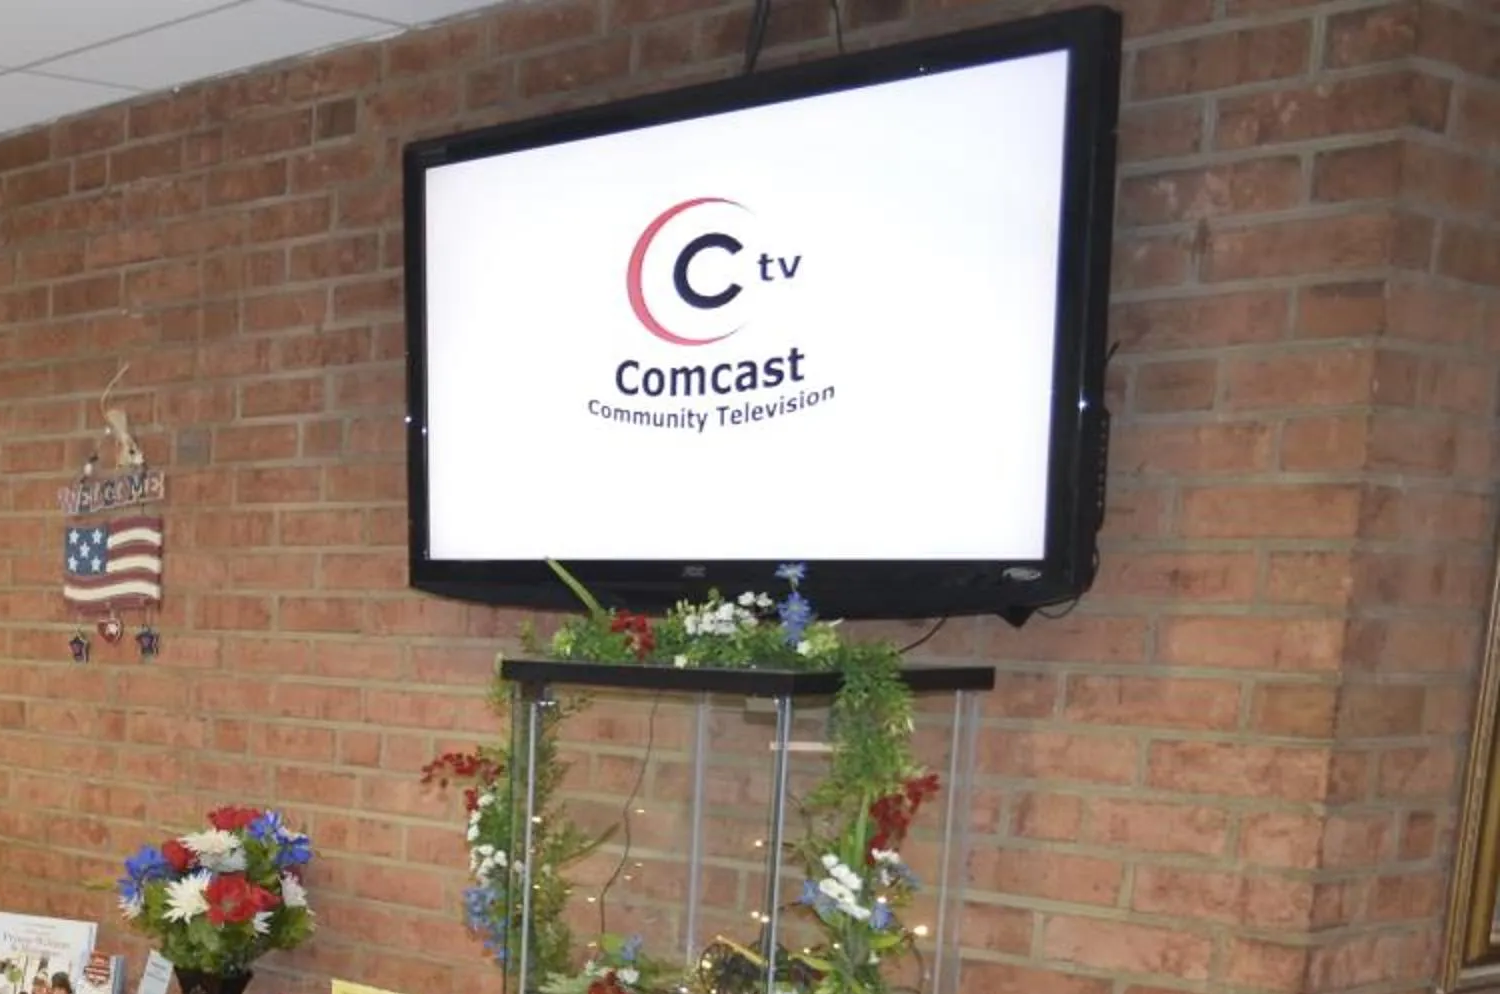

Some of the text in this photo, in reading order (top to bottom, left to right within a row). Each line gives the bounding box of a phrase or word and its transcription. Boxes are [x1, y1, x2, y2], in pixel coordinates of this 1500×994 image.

[757, 252, 802, 281] tv
[615, 347, 805, 397] Comcast
[587, 384, 836, 433] Community Television
